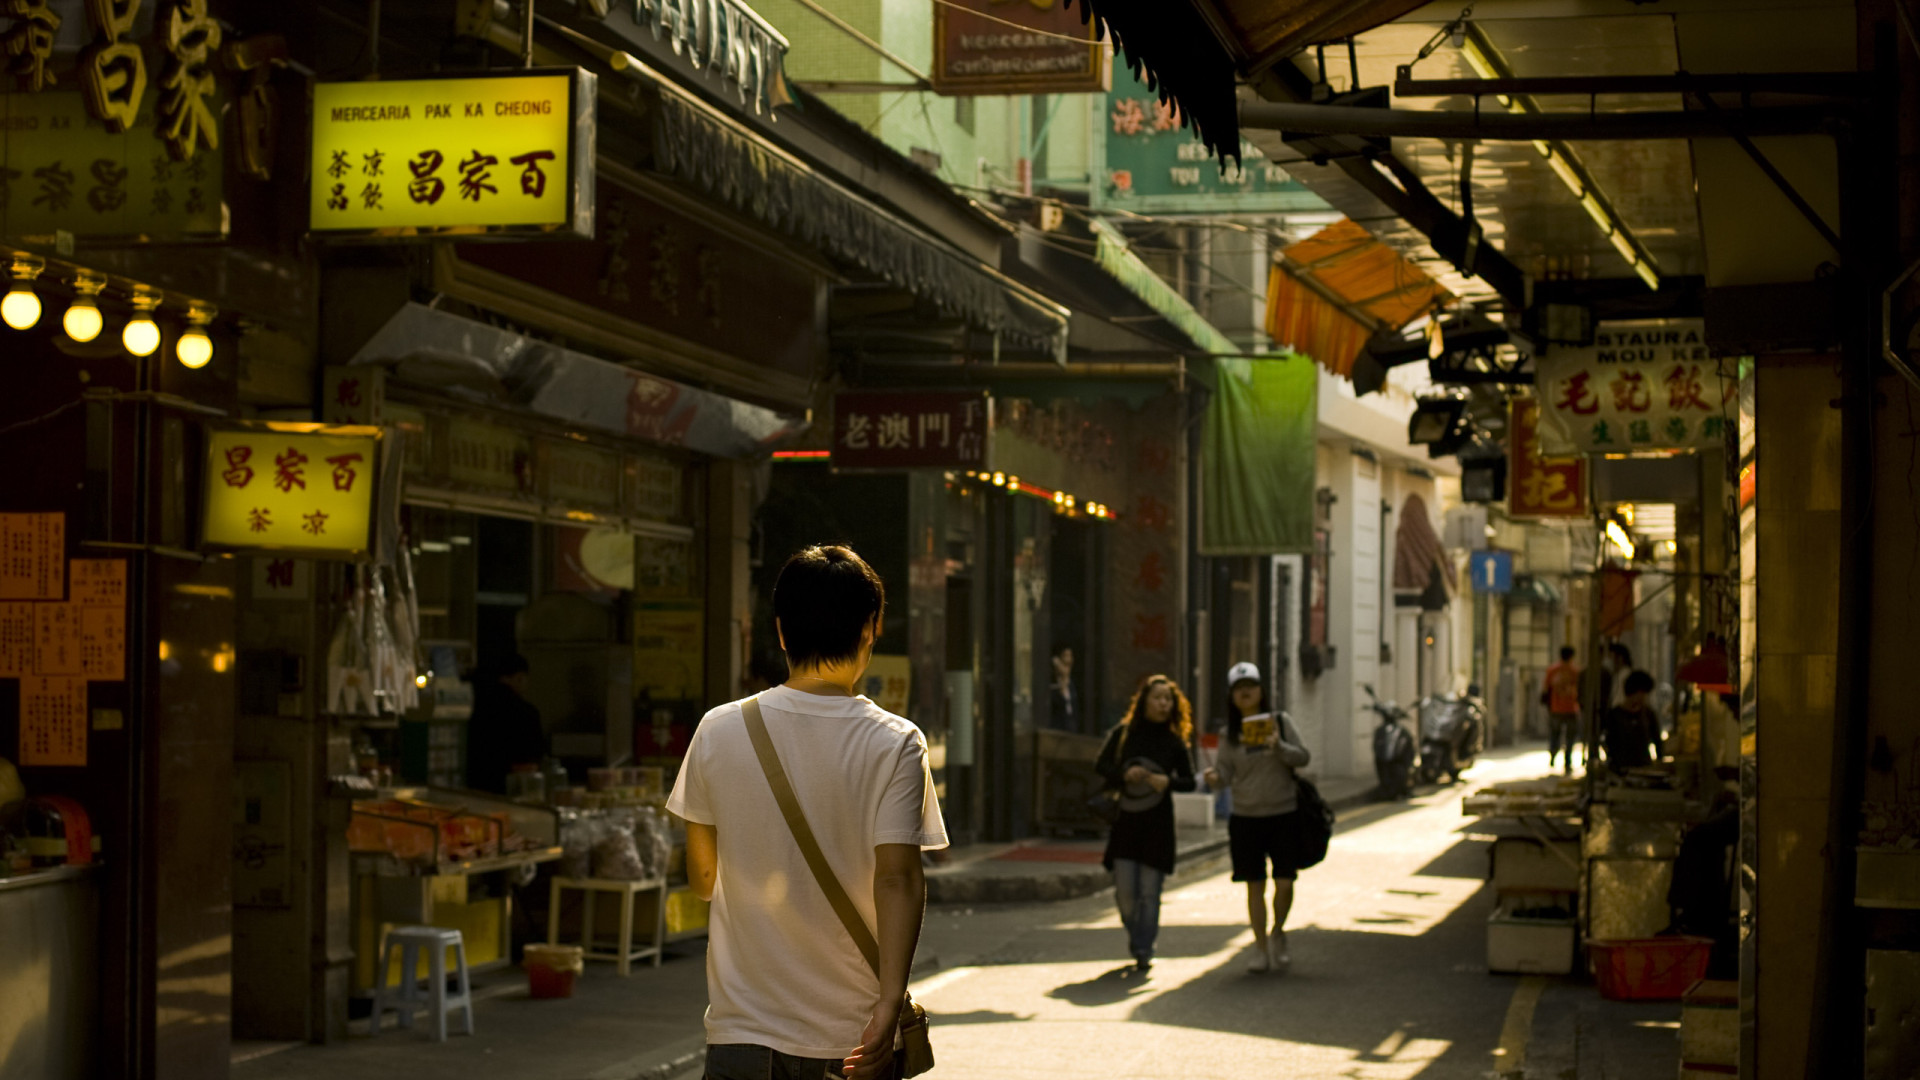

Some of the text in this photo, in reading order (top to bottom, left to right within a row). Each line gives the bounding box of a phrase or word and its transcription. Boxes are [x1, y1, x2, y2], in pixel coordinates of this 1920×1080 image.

[331, 100, 552, 122] MERCEARIA PAK KA CHEONG
[1590, 329, 1699, 347] STAURA
[1596, 346, 1707, 363] MOU KE
[841, 412, 951, 450] 老澳門
[956, 398, 983, 461] 手信
